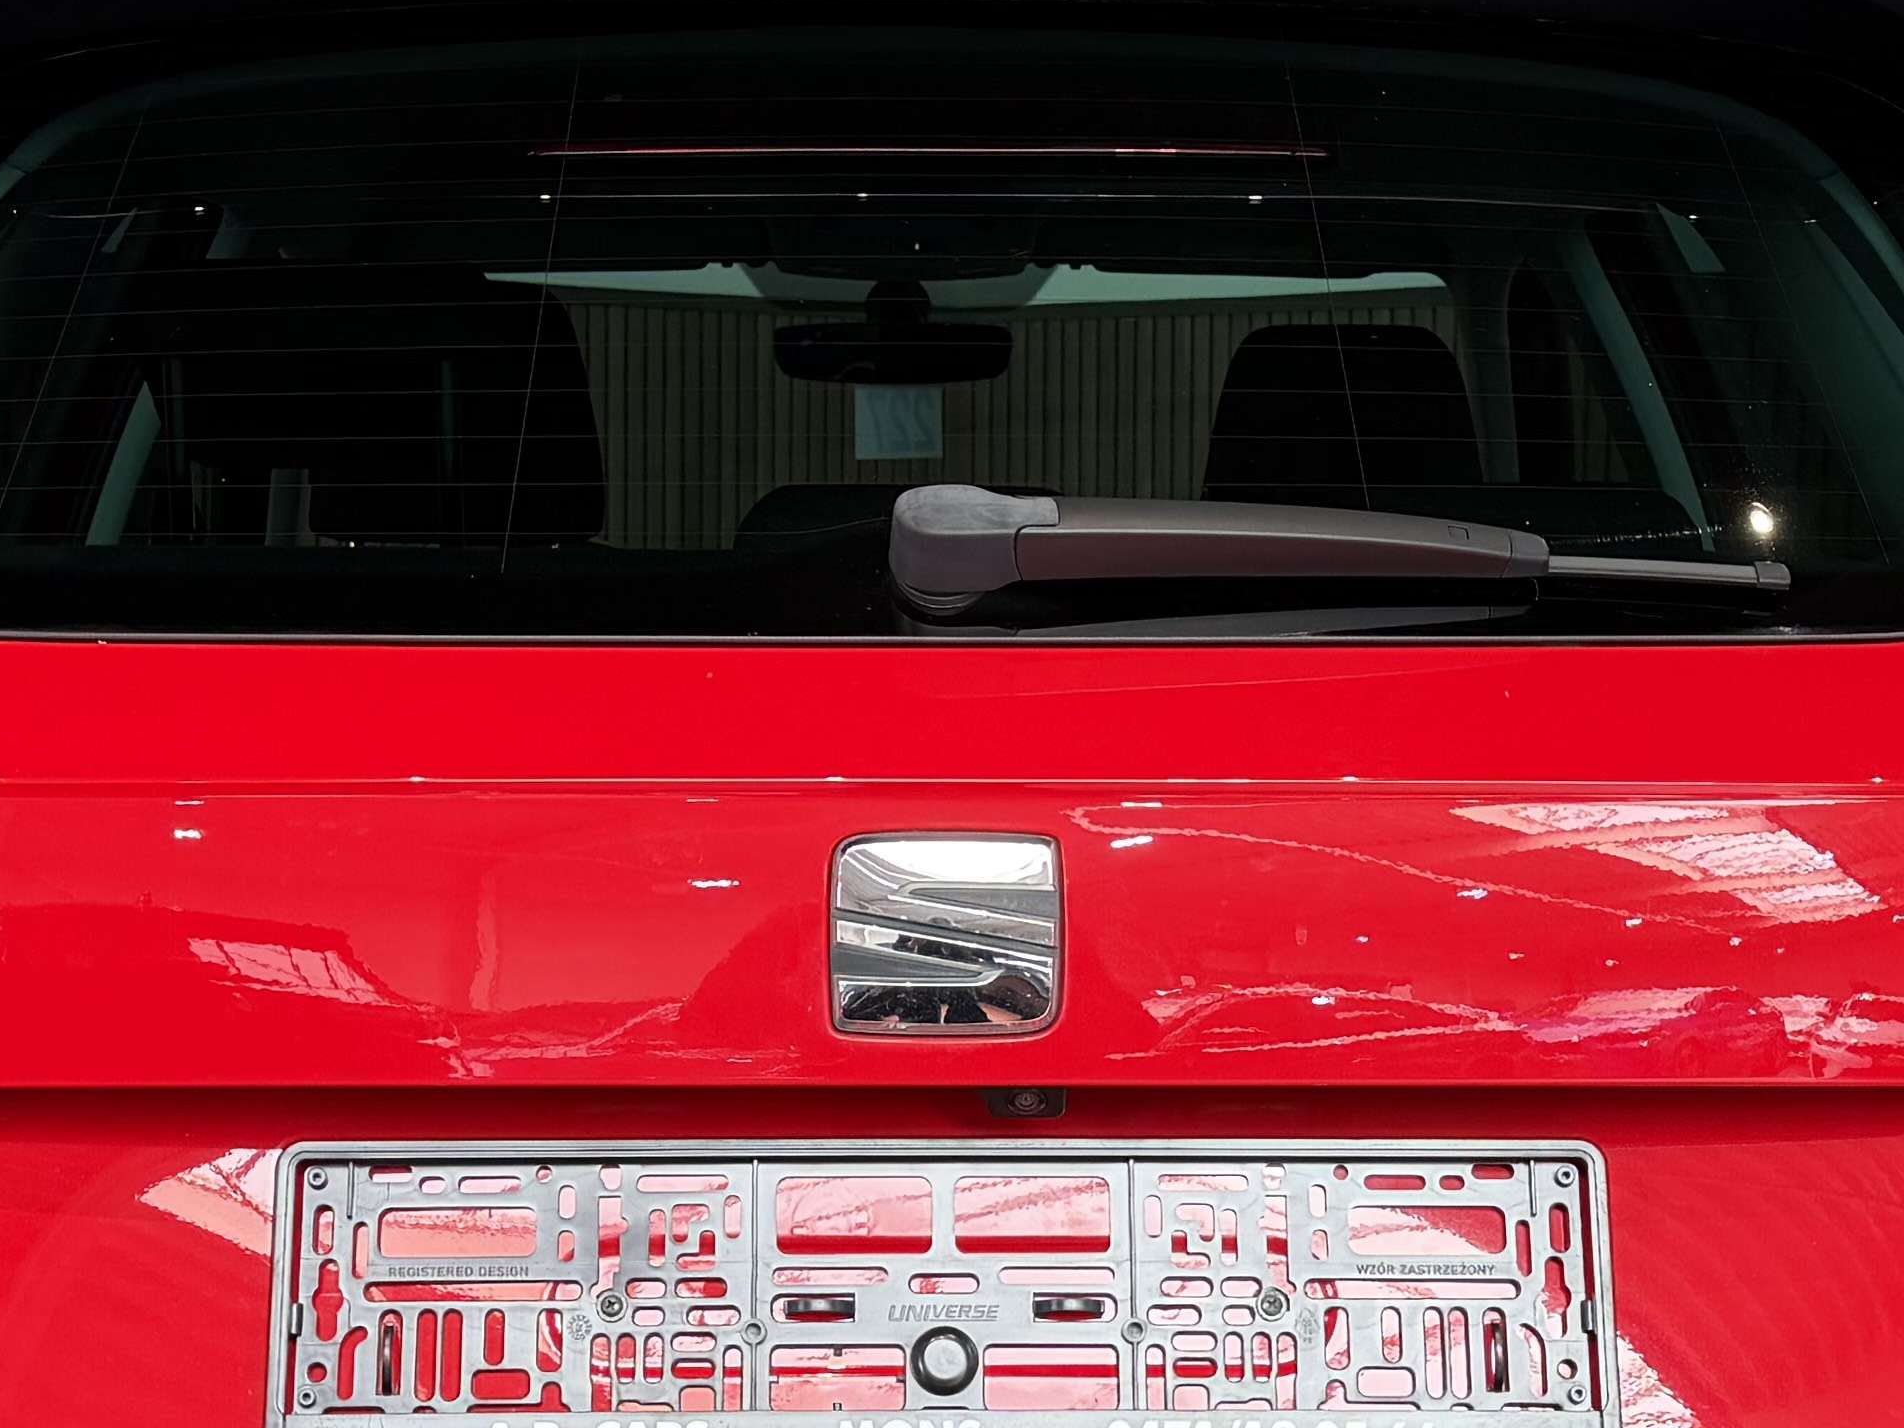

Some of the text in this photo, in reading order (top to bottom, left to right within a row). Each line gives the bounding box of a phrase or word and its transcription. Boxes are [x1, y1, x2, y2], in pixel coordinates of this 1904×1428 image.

[388, 1265, 530, 1278] REGISTERED DESIGN
[1355, 1261, 1496, 1276] WZÓR ZASTRZEŻONY
[887, 1304, 1000, 1322] UNIVERSE
